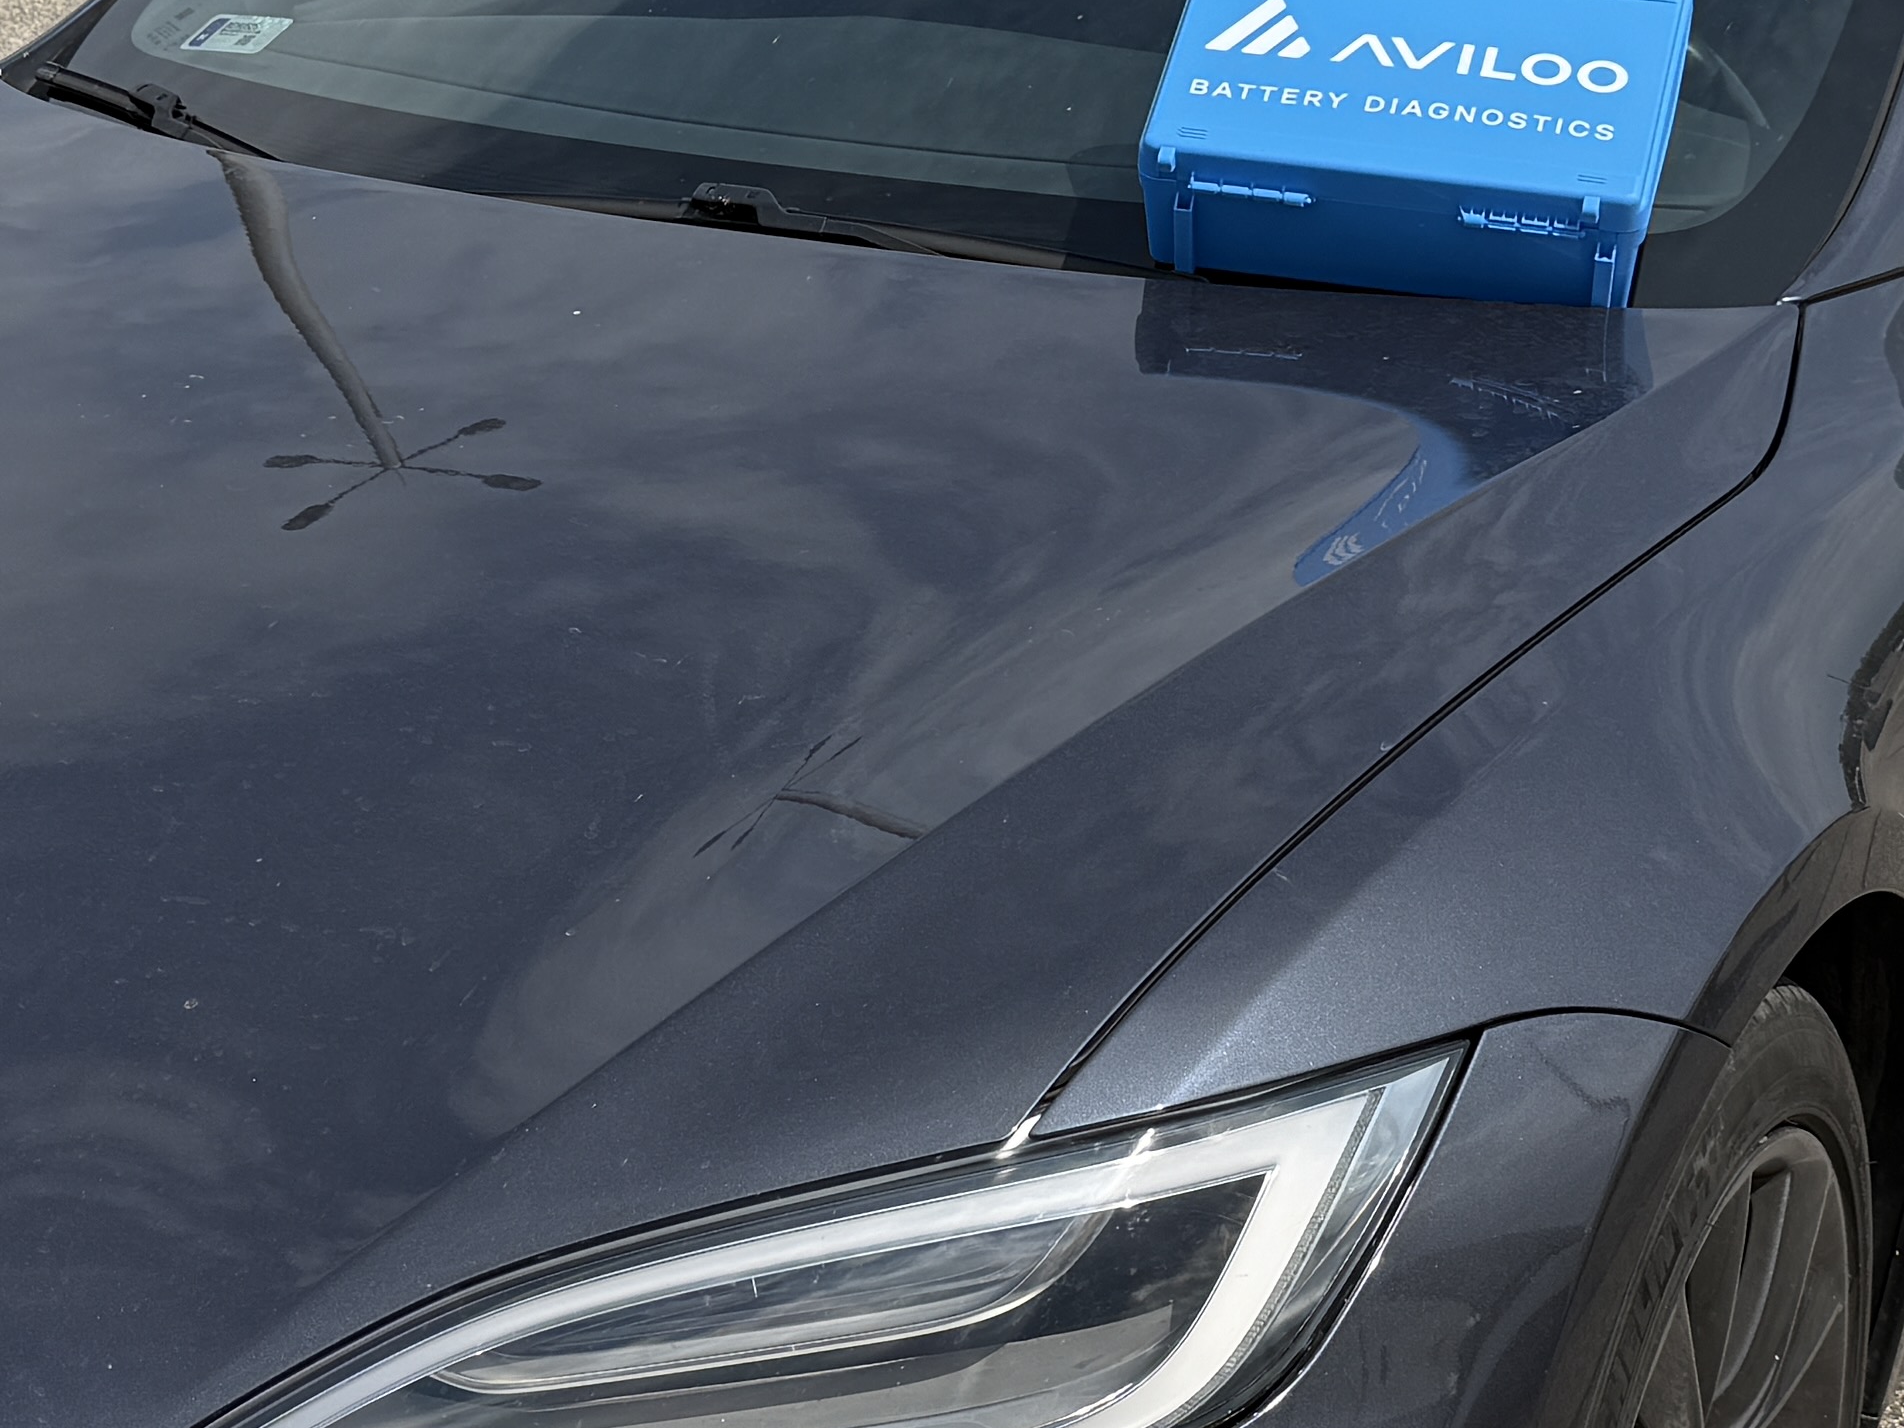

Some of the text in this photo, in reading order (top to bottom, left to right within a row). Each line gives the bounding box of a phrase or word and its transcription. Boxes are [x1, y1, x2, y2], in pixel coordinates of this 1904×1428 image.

[1329, 33, 1629, 94] AVILOO
[1188, 77, 1616, 142] BATTERY DIAGNOSTICS
